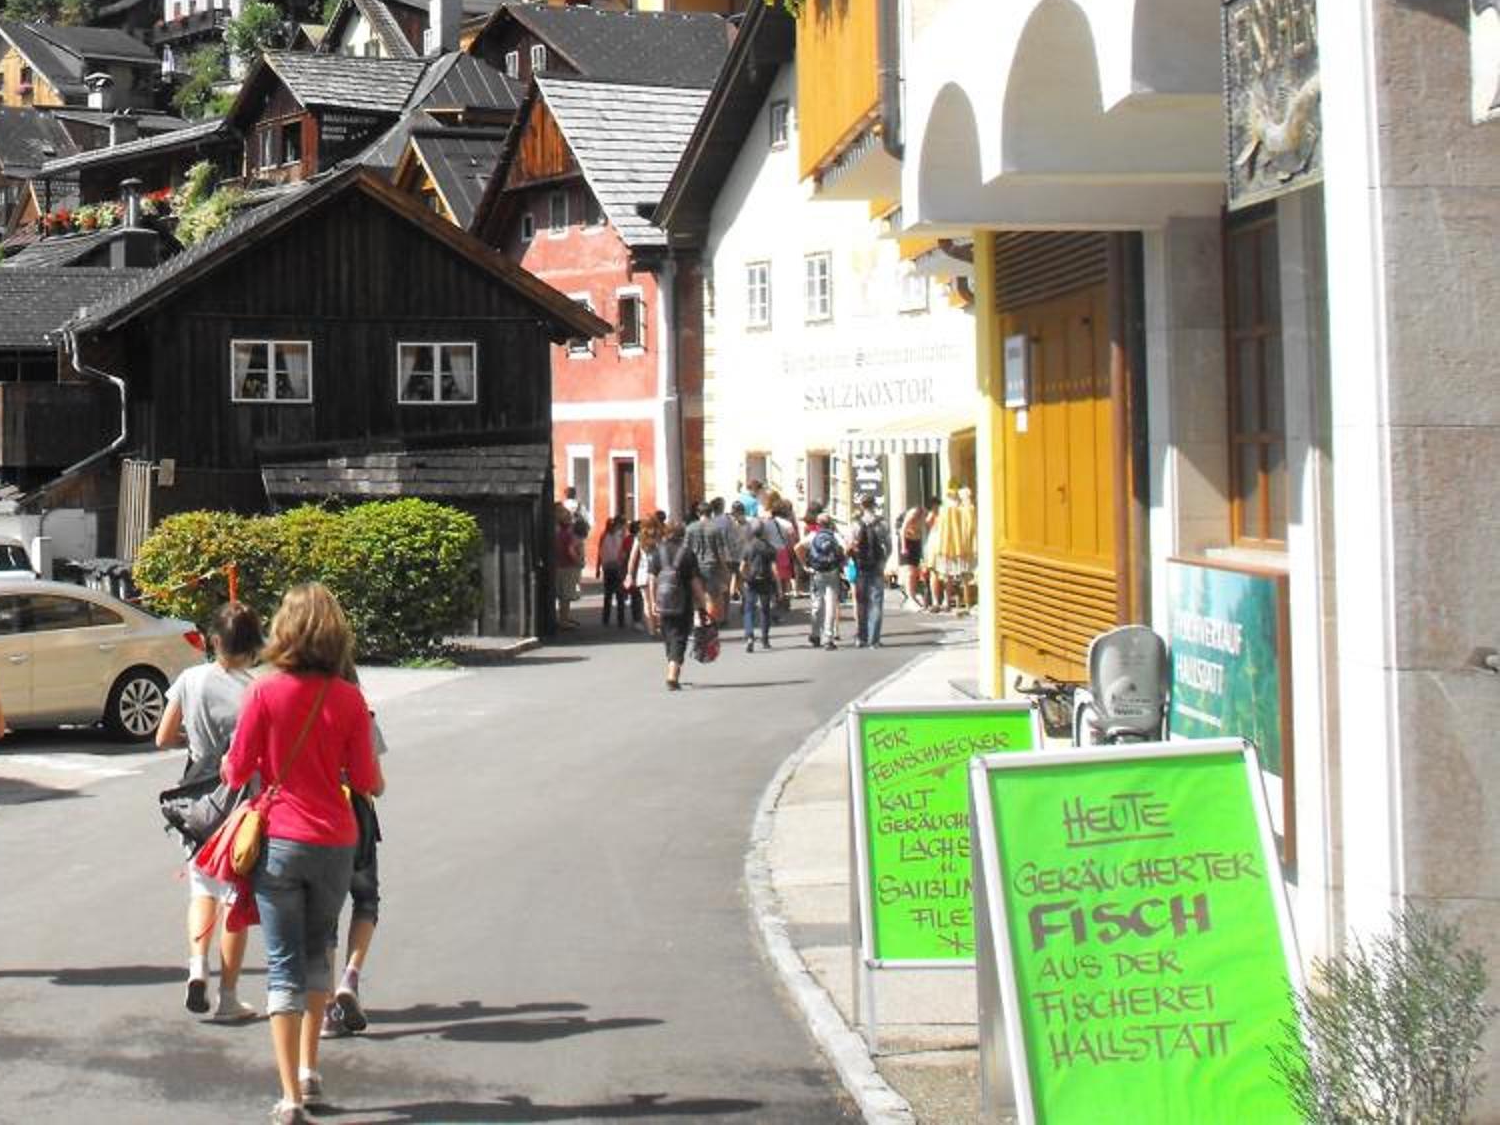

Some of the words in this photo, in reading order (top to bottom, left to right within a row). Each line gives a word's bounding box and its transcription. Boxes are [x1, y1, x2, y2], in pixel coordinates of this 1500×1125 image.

[803, 377, 934, 411] SALZKONTOR
[877, 788, 936, 812] KALT
[1062, 792, 1172, 841] HEUTE
[900, 836, 972, 862] LACHS
[1012, 851, 1262, 898] GERÄUCHERTER
[909, 906, 973, 930] FILE
[1026, 892, 1212, 954] FISCH
[1036, 953, 1103, 984] AUS
[1111, 948, 1184, 978] DER
[1032, 983, 1216, 1025] FISCHEREI
[1048, 1019, 1237, 1071] HALLSTATT
